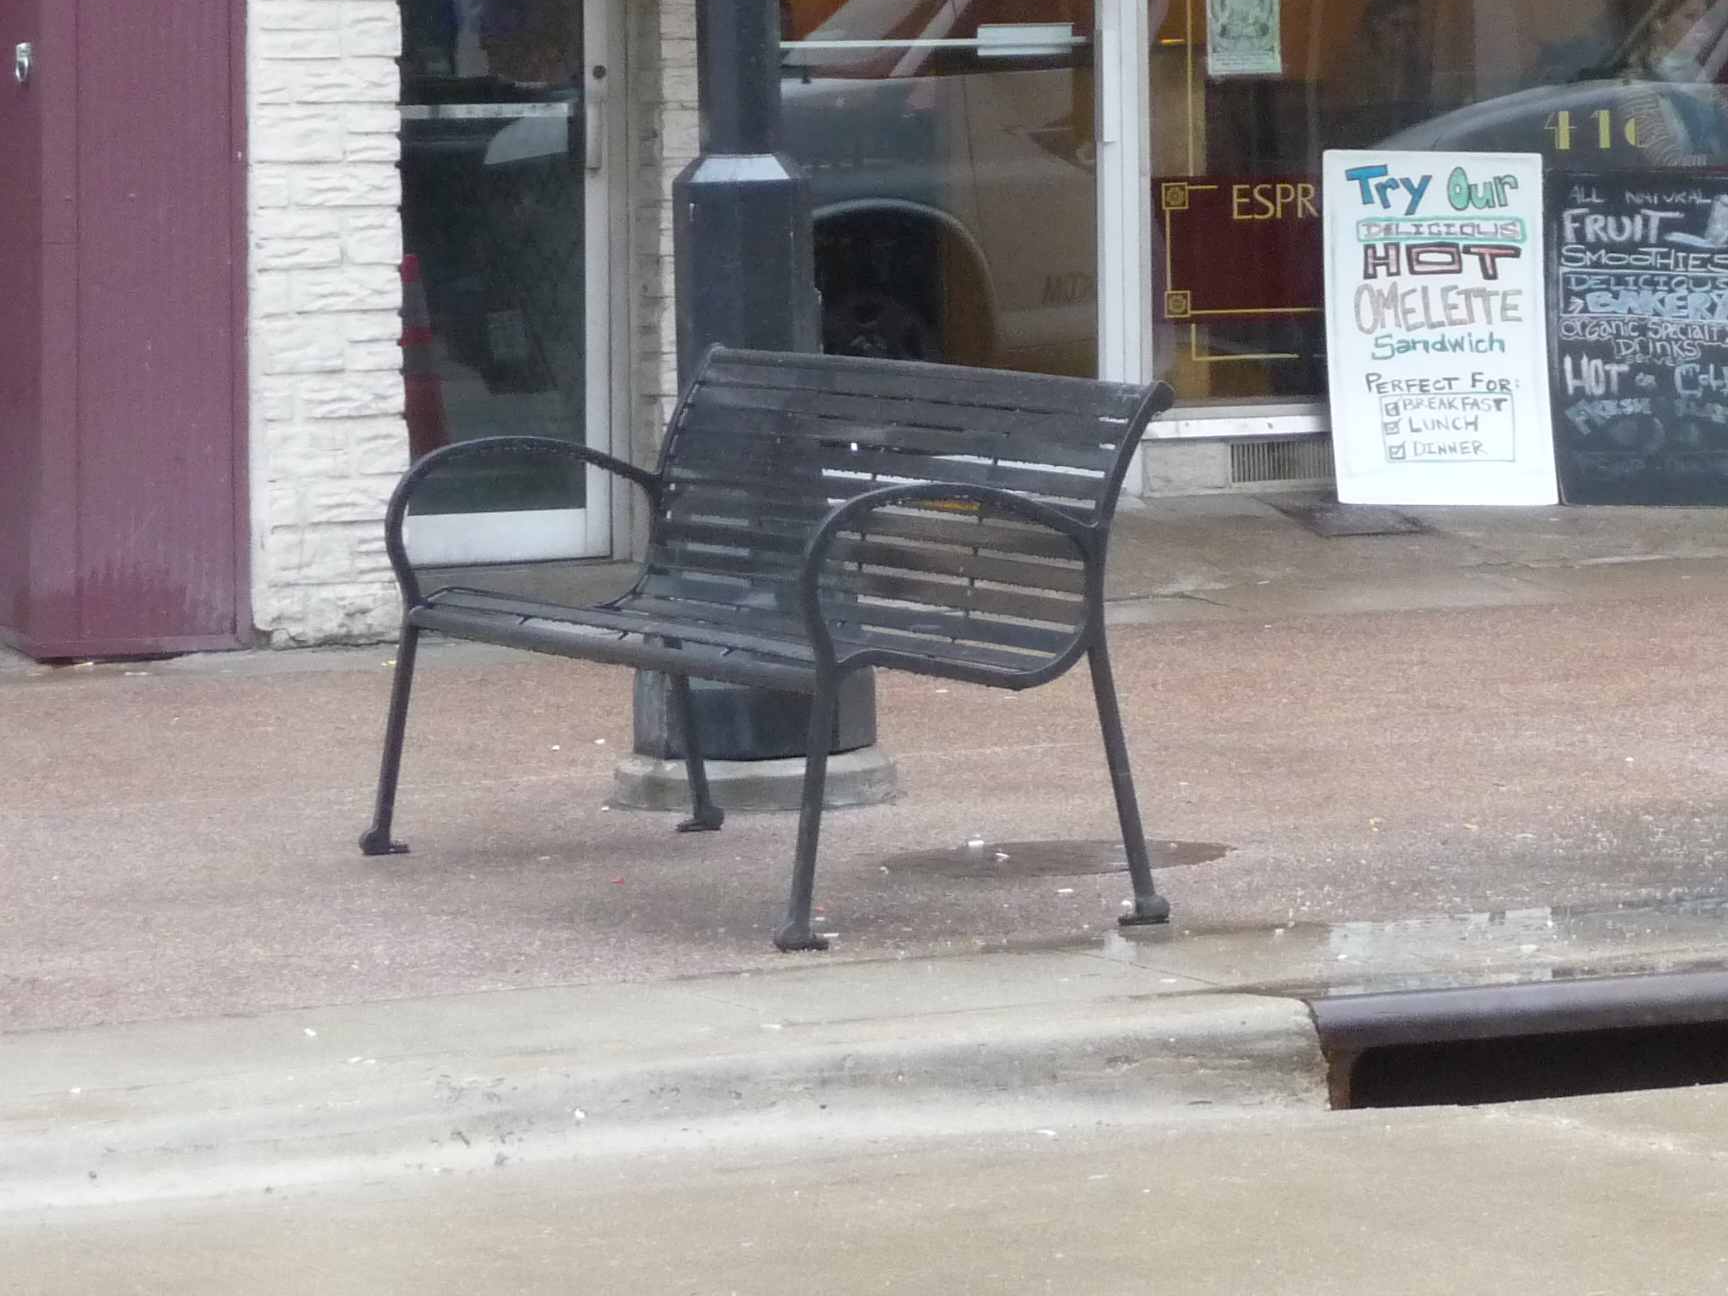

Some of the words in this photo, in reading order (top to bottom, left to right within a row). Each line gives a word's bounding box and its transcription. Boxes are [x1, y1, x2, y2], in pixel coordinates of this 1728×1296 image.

[1232, 183, 1320, 220] ESPR
[1345, 164, 1433, 216] Try
[1447, 166, 1519, 211] Our
[1569, 185, 1606, 204] ALL
[1362, 222, 1521, 240] DELICIOUS
[1563, 208, 1685, 244] FRUIT
[1363, 241, 1522, 281] HOT
[1354, 281, 1524, 335] OMELETTE
[1371, 331, 1506, 360] Sandwich
[1365, 372, 1460, 395] PERFECT
[1563, 354, 1630, 395] HOT
[1403, 396, 1508, 412] BREAKFAST
[1408, 415, 1480, 433] LUNCH
[1413, 440, 1488, 456] DINNER
